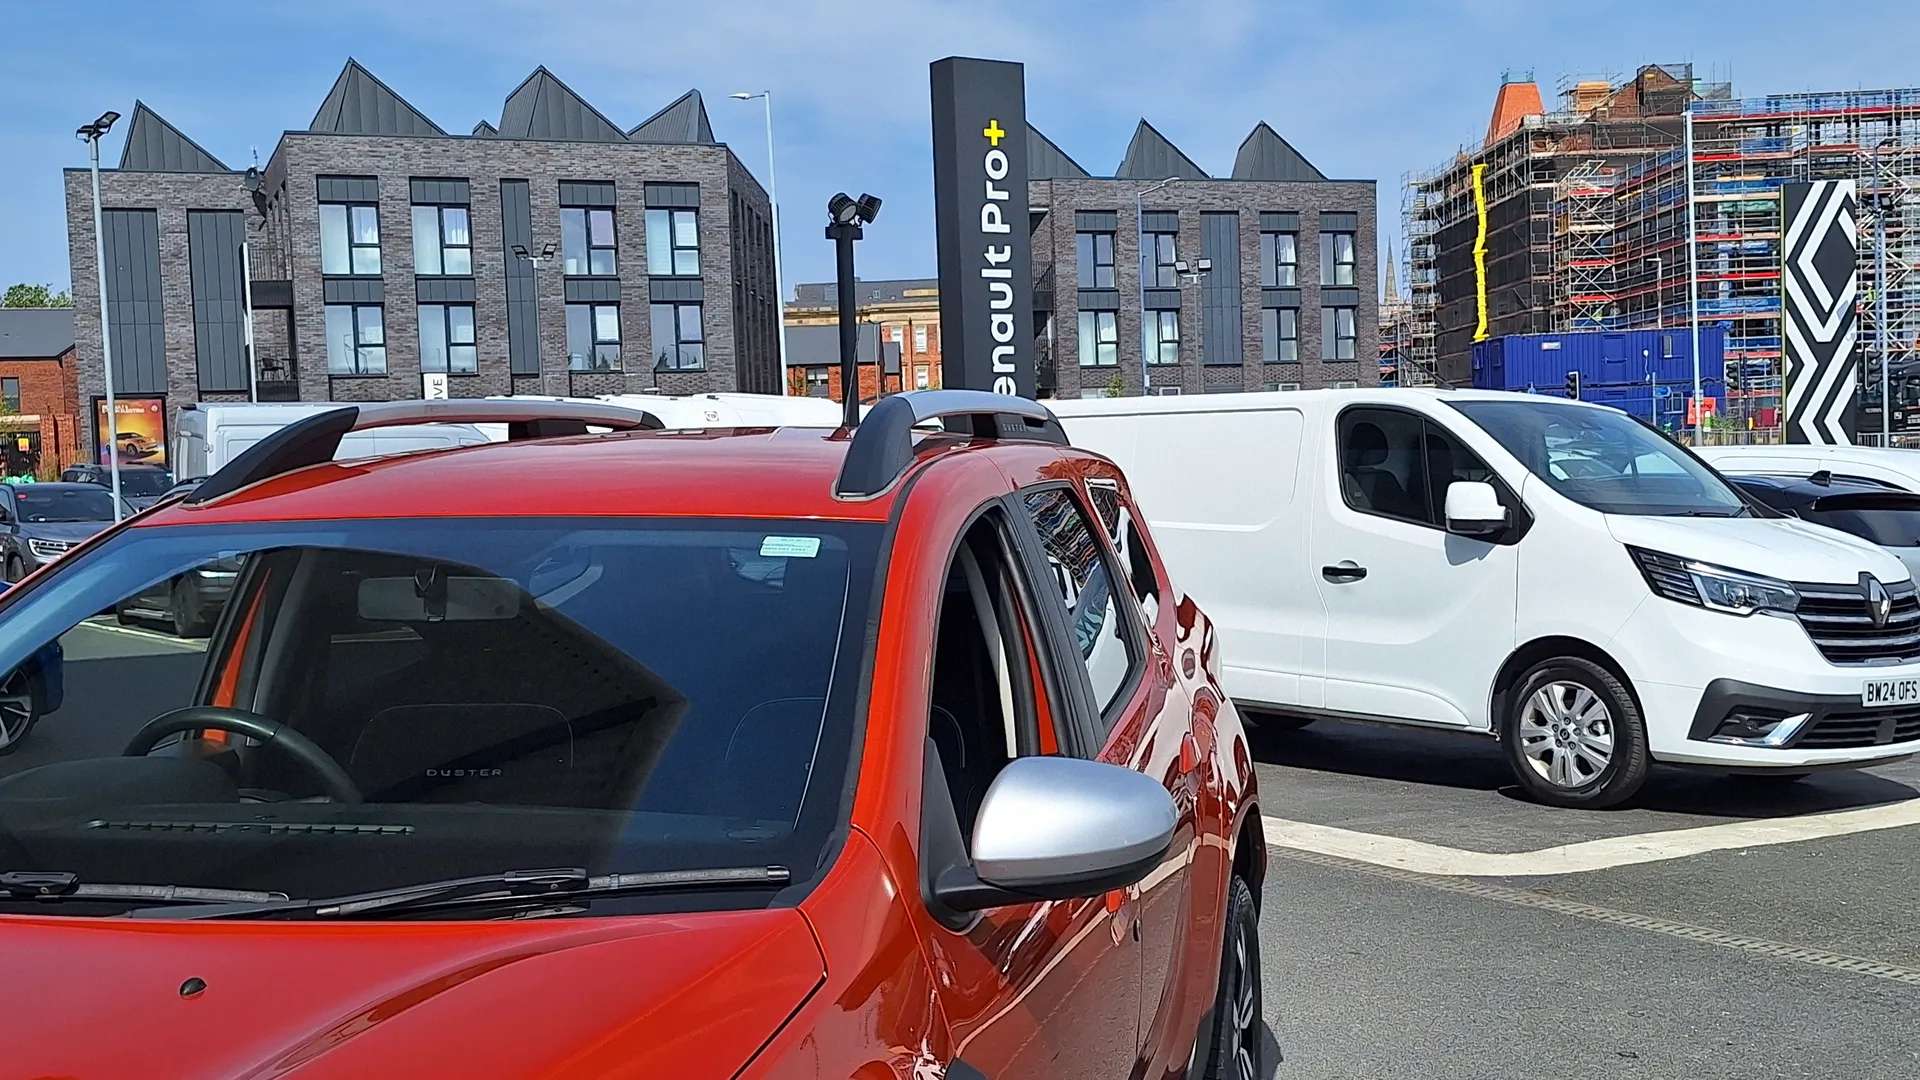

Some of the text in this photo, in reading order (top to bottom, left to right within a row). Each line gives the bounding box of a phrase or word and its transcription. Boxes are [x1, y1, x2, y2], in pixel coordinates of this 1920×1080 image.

[1867, 680, 1918, 702] BW24 OFS
[426, 768, 503, 777] DUSTER
